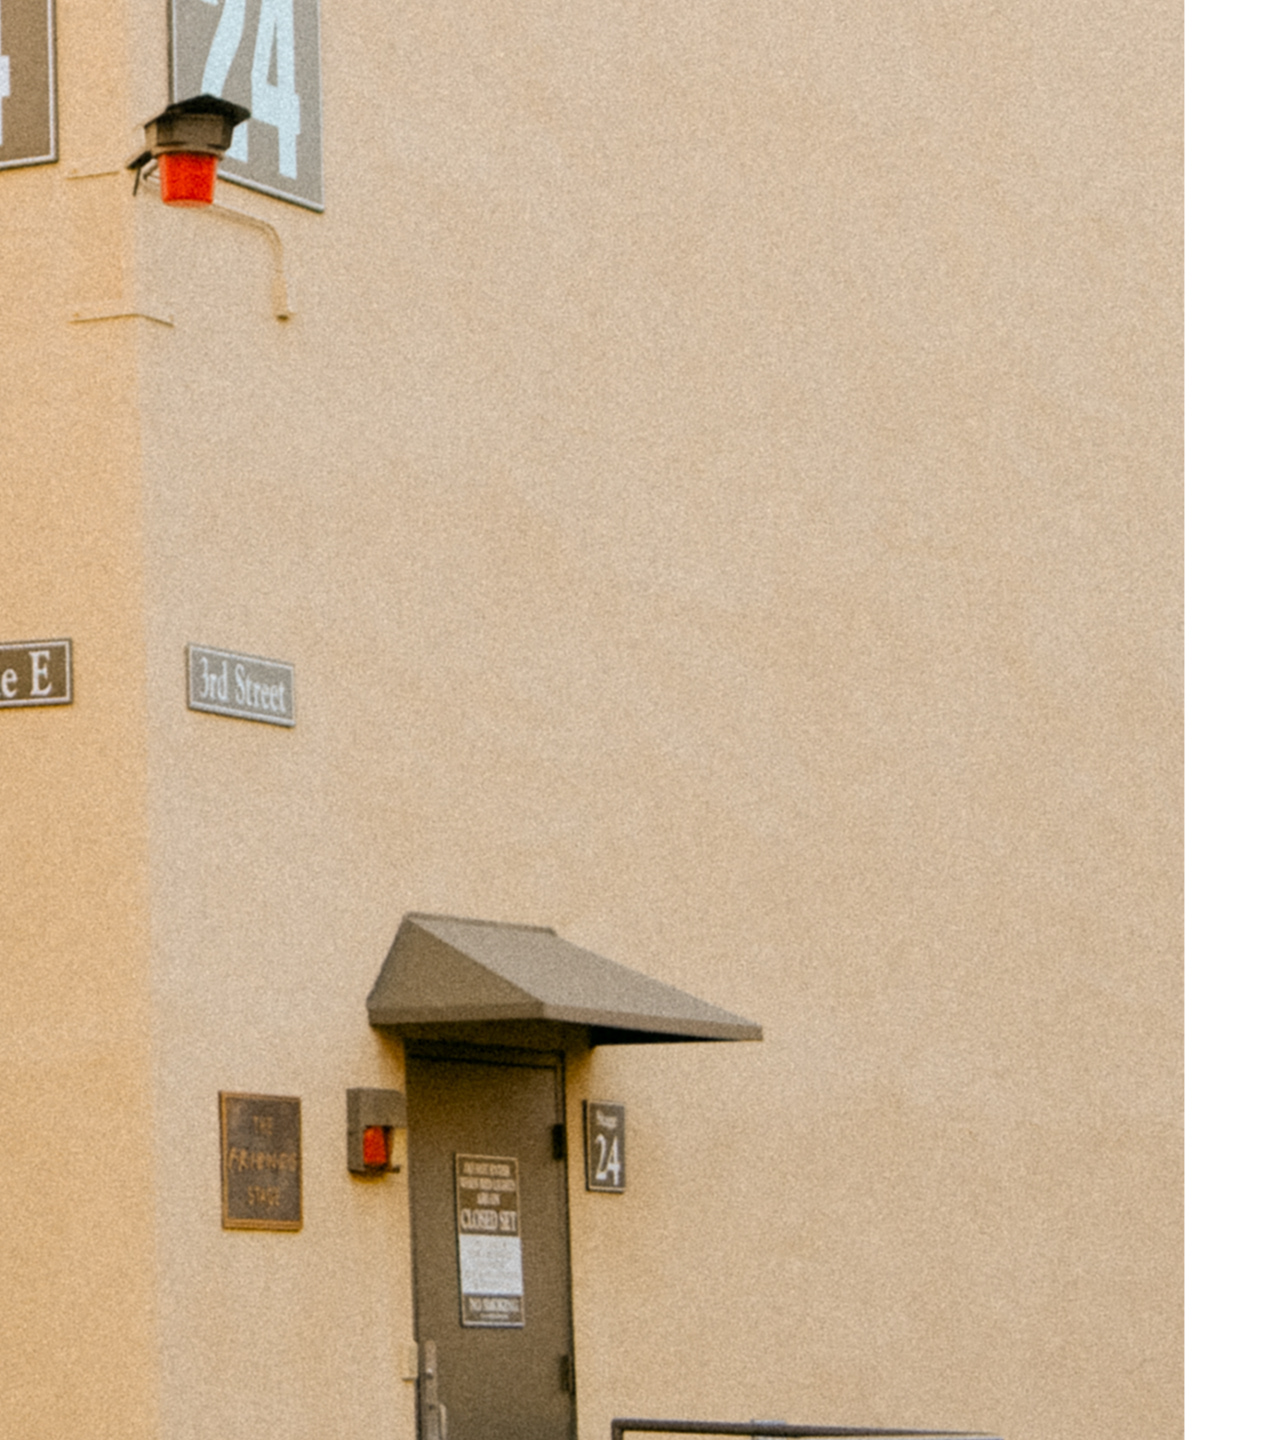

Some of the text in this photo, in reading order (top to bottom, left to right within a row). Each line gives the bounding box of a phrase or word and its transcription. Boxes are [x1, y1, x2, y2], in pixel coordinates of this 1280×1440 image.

[30, 650, 53, 697] E
[200, 656, 286, 713] 3rd Street
[594, 1133, 622, 1187] 24
